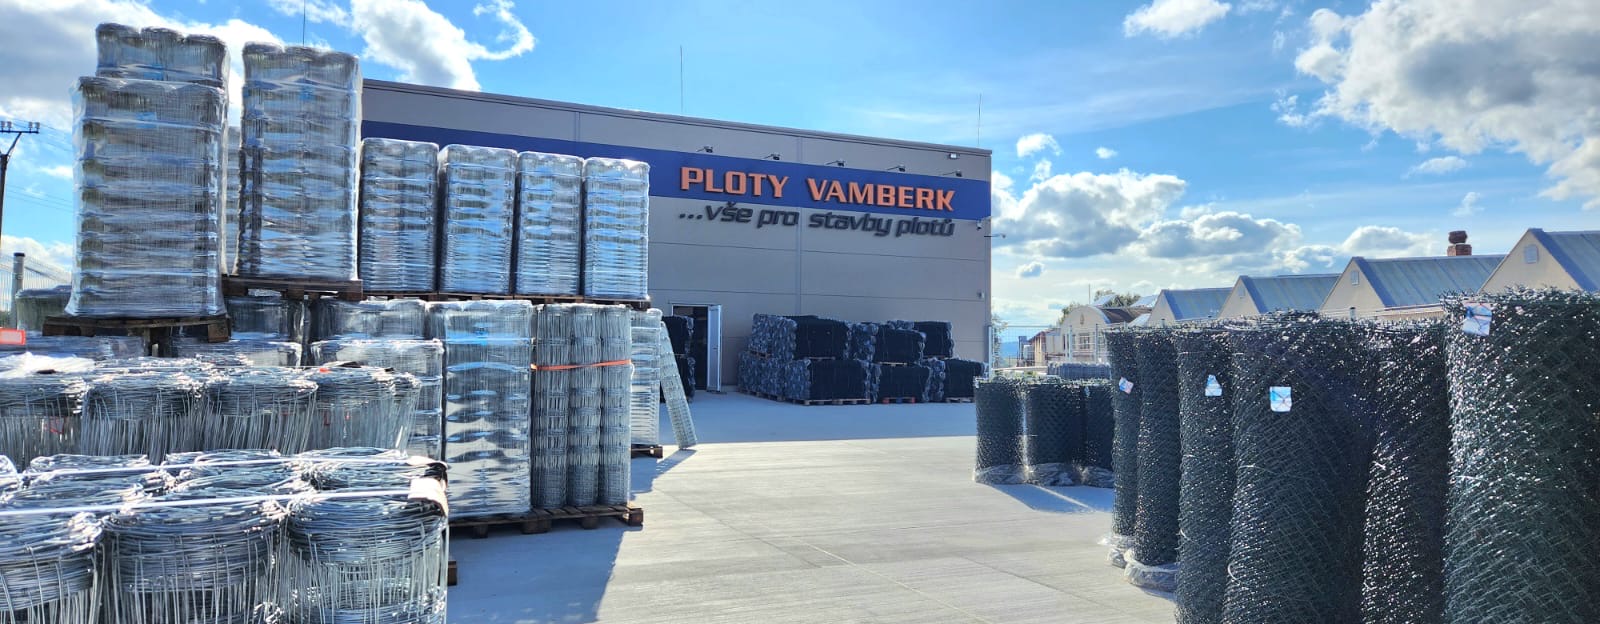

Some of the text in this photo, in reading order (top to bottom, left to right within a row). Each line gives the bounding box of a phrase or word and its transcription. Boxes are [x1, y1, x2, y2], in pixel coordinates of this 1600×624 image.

[680, 166, 955, 211] PLOTY VAMBERK
[679, 201, 955, 237] ...vše pro stavby plotů
